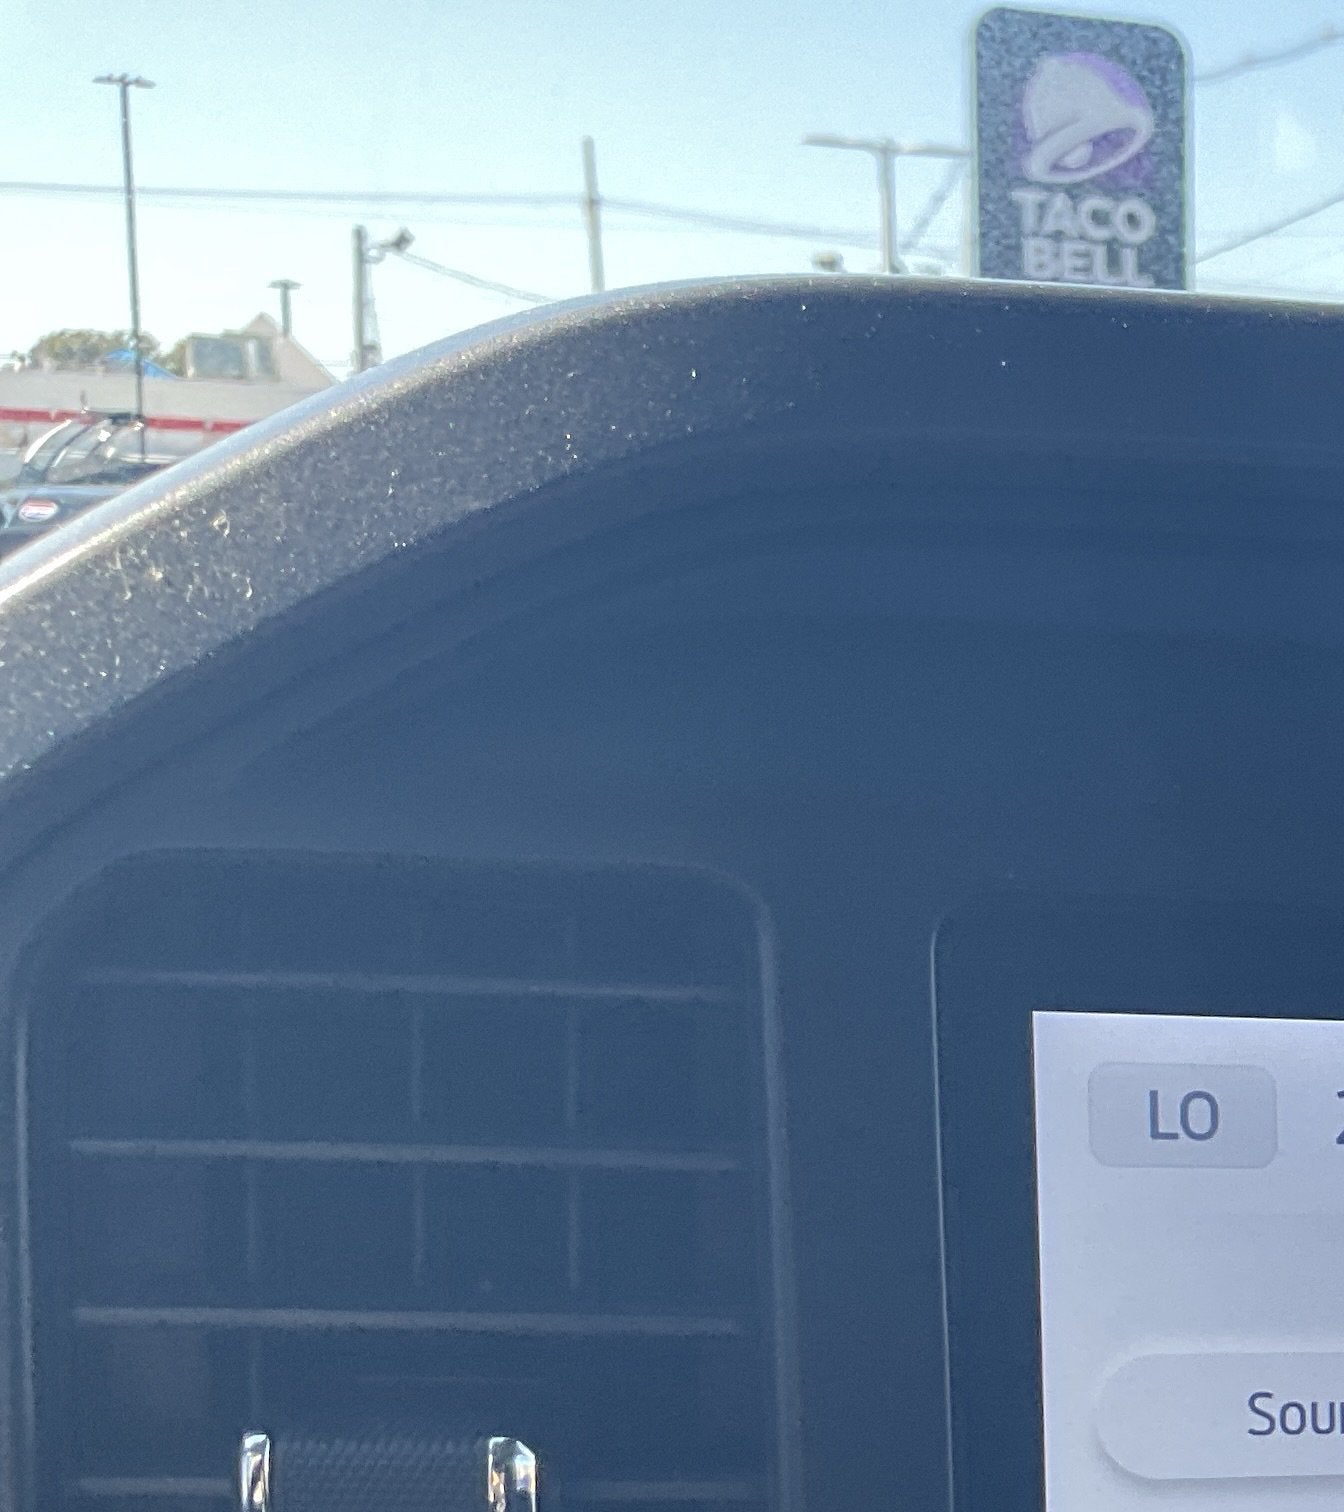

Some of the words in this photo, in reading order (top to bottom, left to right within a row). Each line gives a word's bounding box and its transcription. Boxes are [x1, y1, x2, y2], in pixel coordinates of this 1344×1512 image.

[1011, 190, 1156, 245] TACO
[1021, 237, 1154, 287] BELL
[1148, 1089, 1220, 1141] LO
